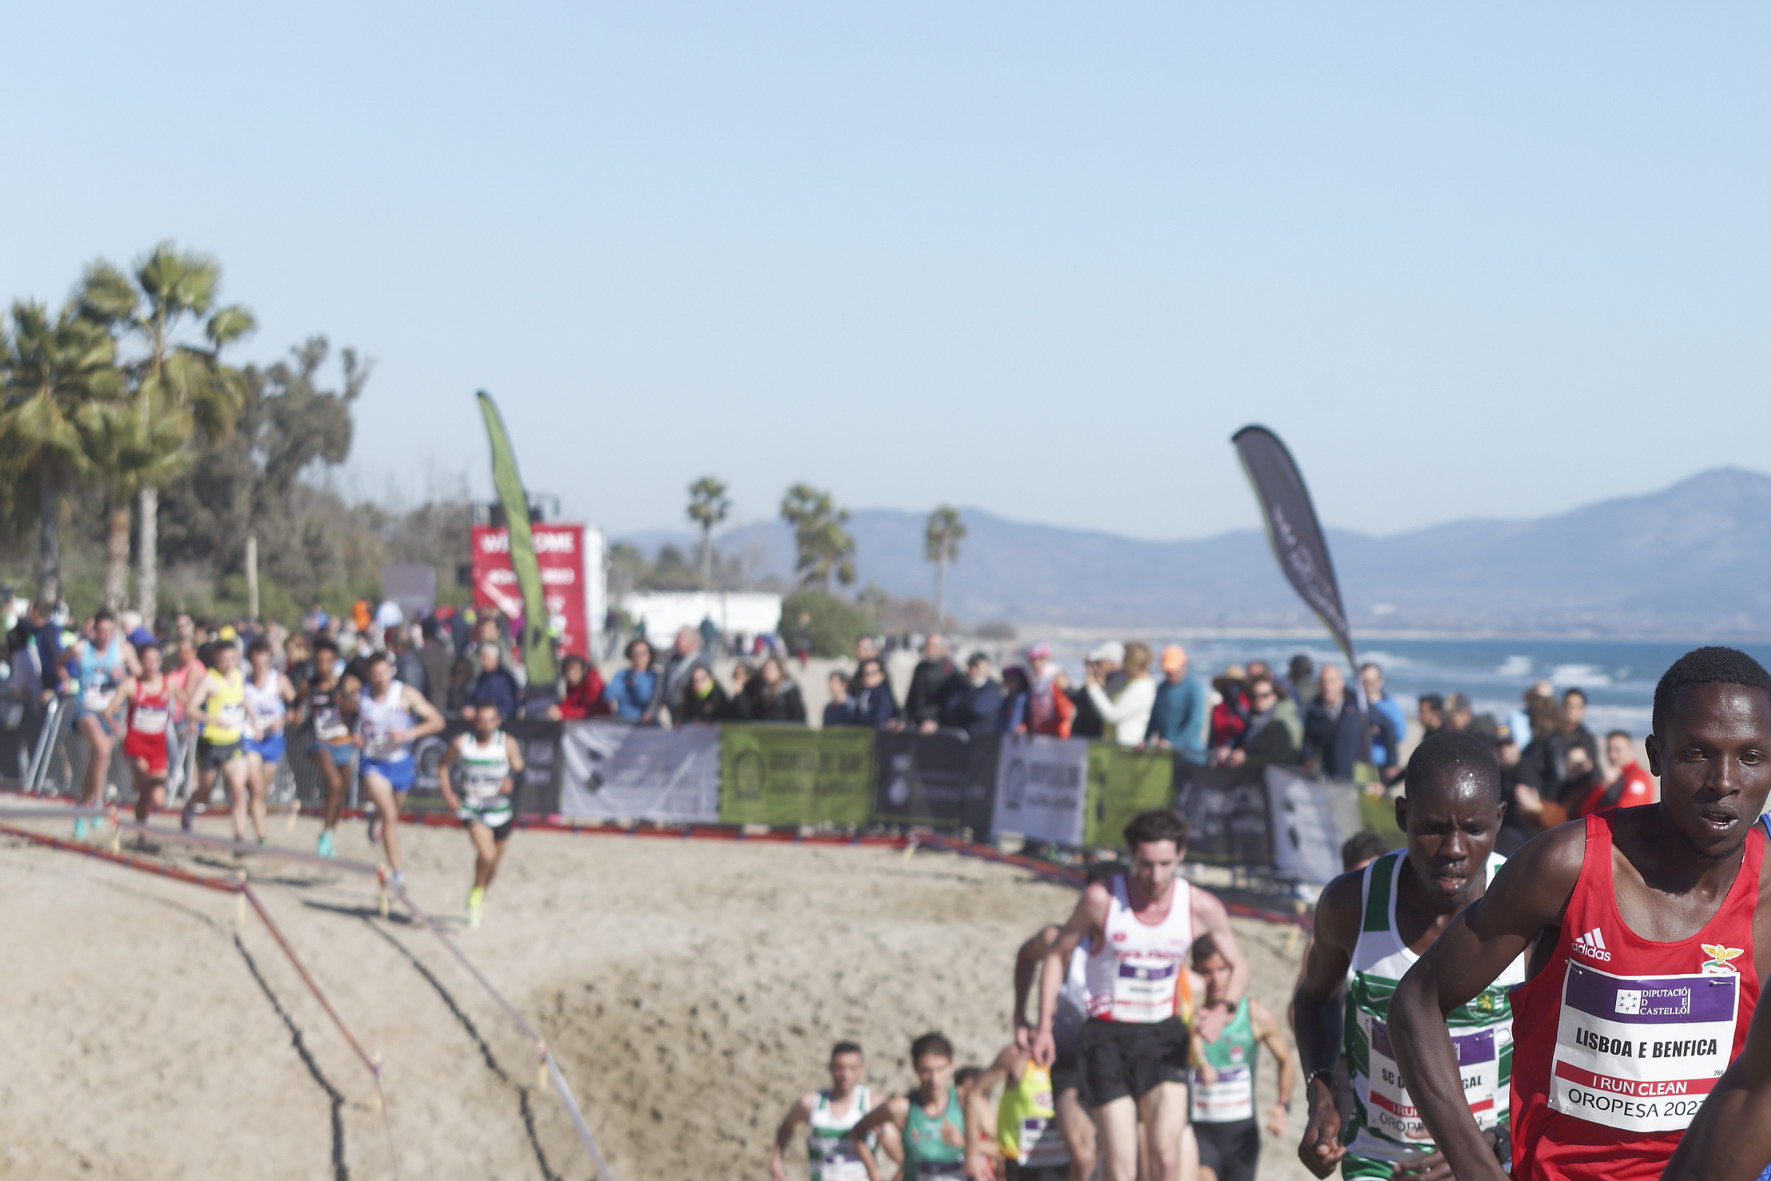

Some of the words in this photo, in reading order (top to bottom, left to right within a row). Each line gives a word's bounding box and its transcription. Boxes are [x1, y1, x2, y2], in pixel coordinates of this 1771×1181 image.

[1571, 942, 1611, 962] adidas
[1642, 986, 1688, 998] DIPUTACIÓ
[1640, 1004, 1687, 1015] CASTELLÓ
[1575, 1027, 1632, 1058] LISBOA
[1638, 1042, 1648, 1058] E
[1652, 1039, 1718, 1058] BENFICA
[1382, 1068, 1395, 1085] SC
[1398, 1076, 1406, 1088] D
[1601, 1077, 1635, 1095] RUN
[1638, 1081, 1688, 1096] CLEAN
[1568, 1088, 1659, 1118] OROPESA
